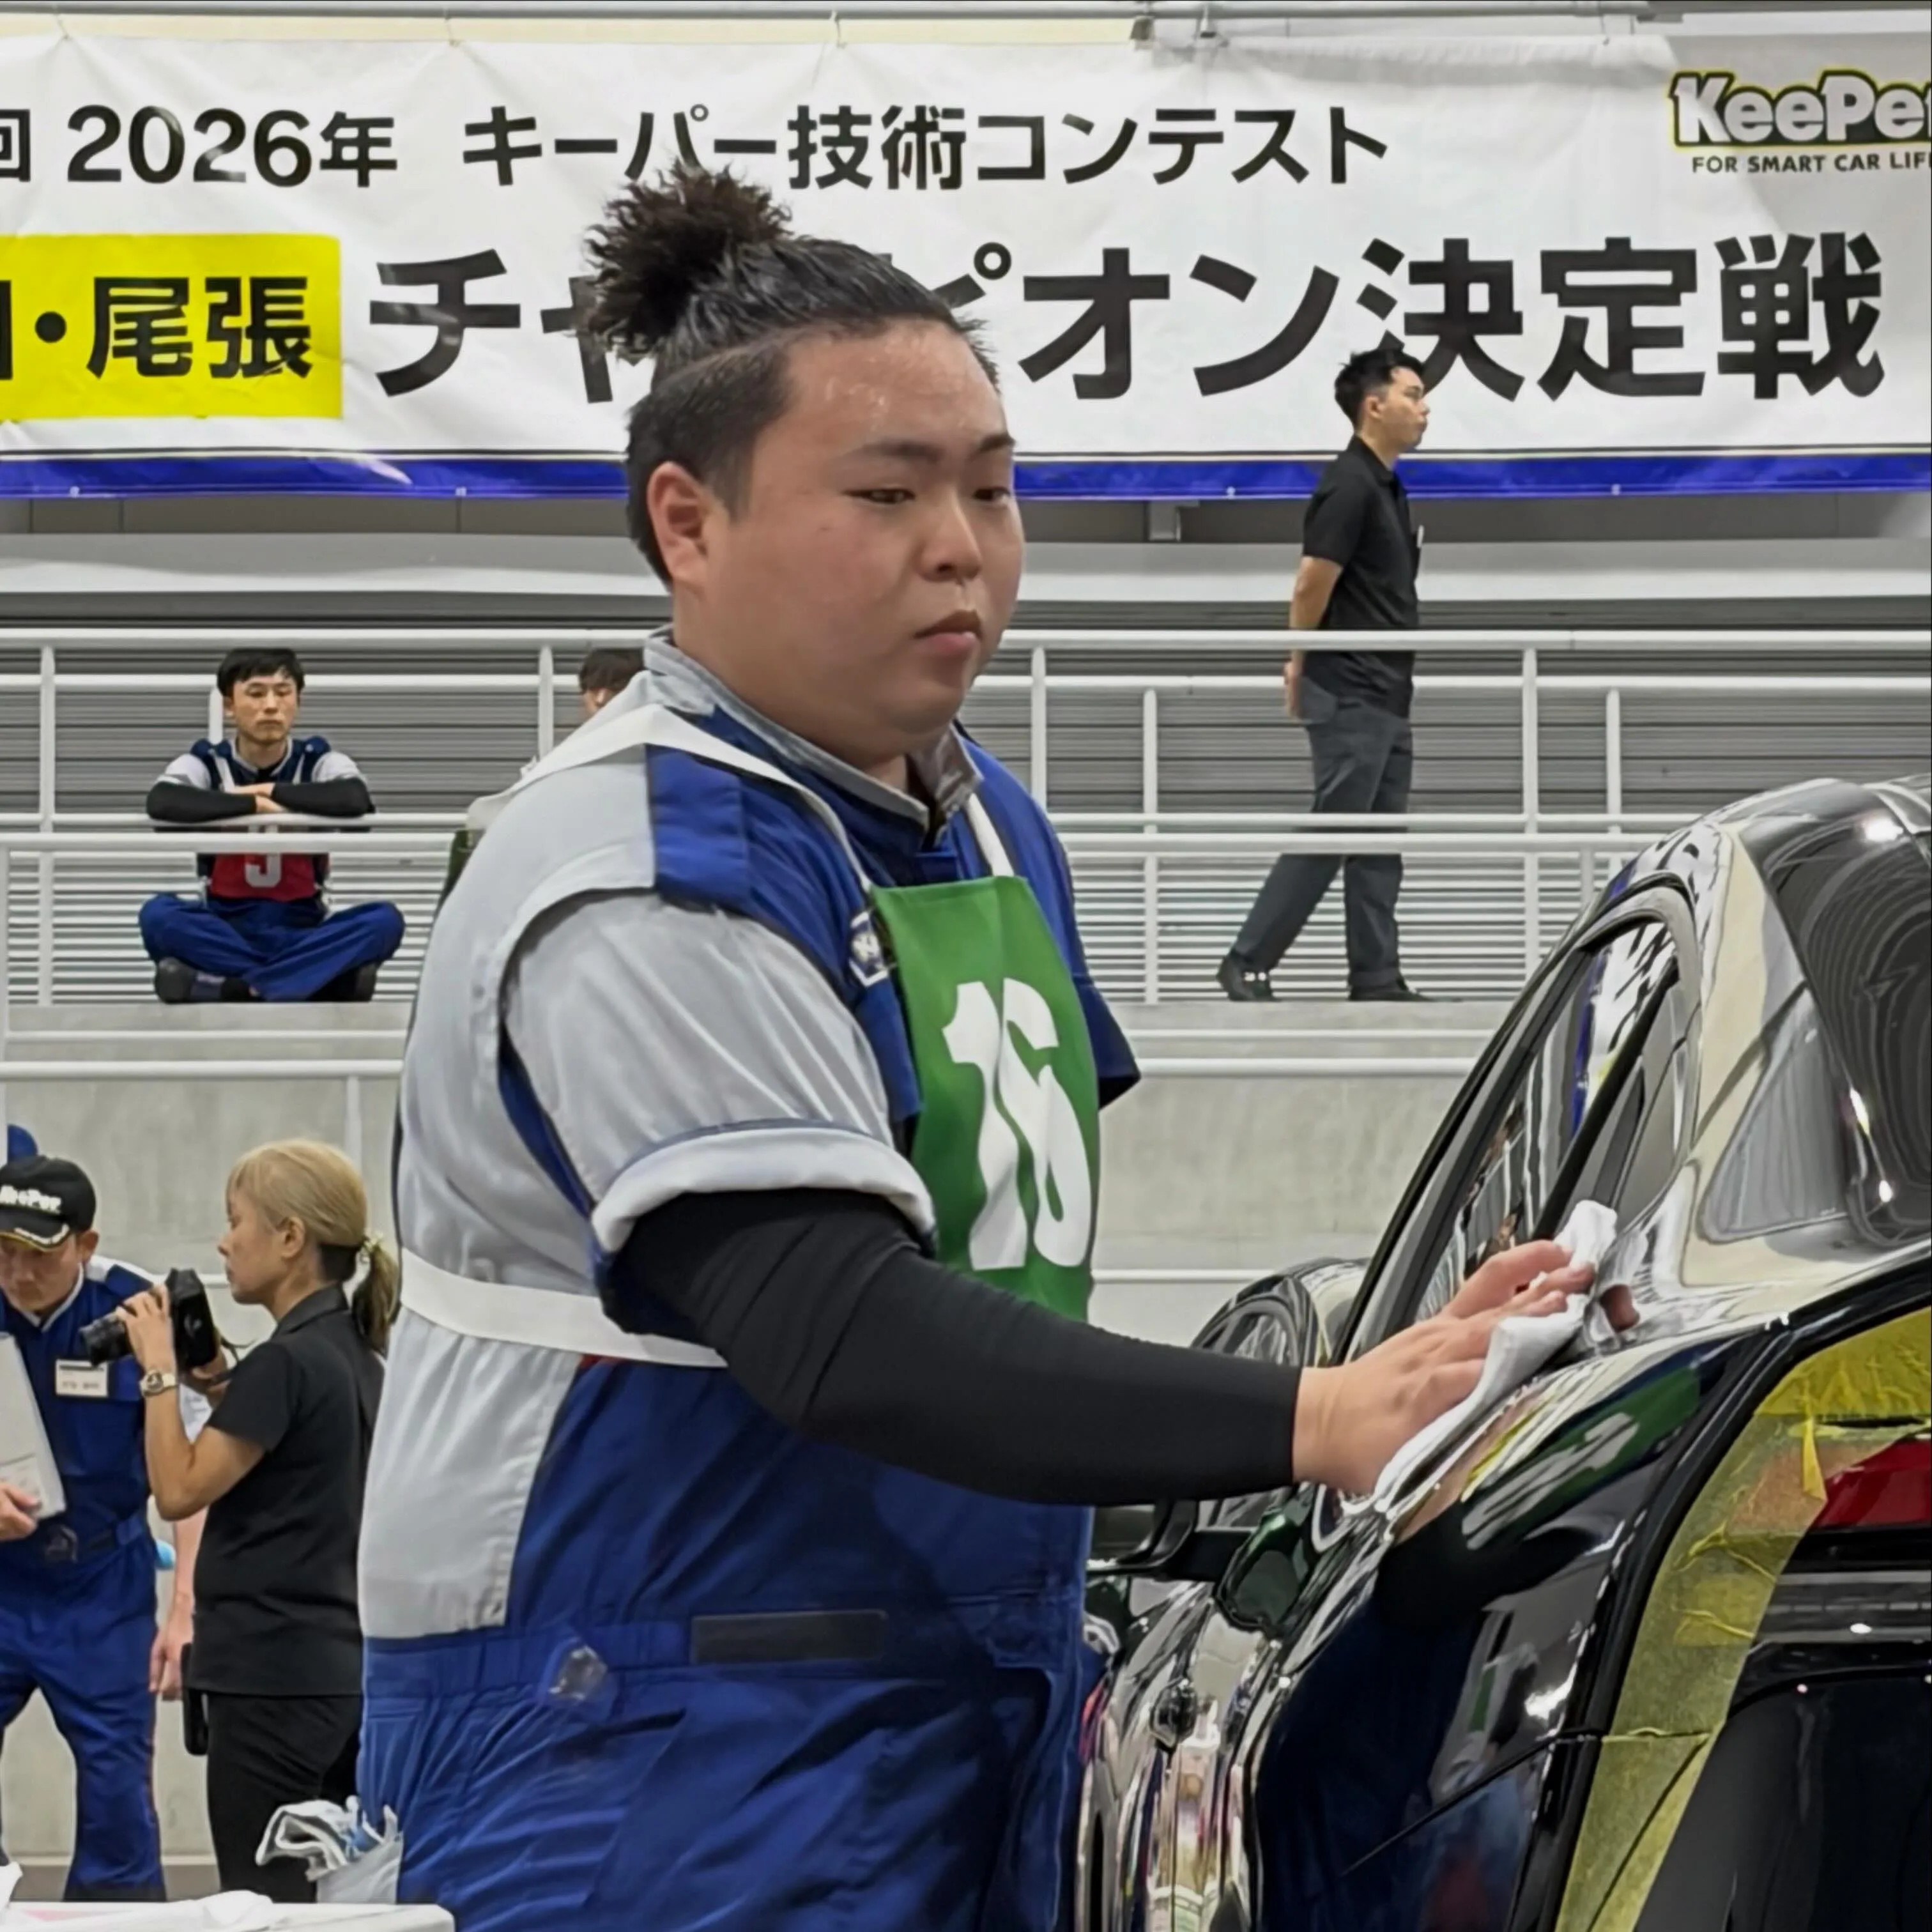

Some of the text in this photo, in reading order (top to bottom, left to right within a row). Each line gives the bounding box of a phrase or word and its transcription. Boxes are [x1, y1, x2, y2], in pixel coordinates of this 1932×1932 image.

[67, 104, 397, 188] 2026年
[463, 103, 1388, 190] キーパー技術コンテスト
[1668, 68, 1931, 146] KeePe
[1692, 155, 1738, 174] FOR
[1747, 154, 1827, 174] SMART
[1834, 153, 1881, 172] CAR
[0, 277, 312, 379] ・尾張
[942, 977, 1092, 1271] 16
